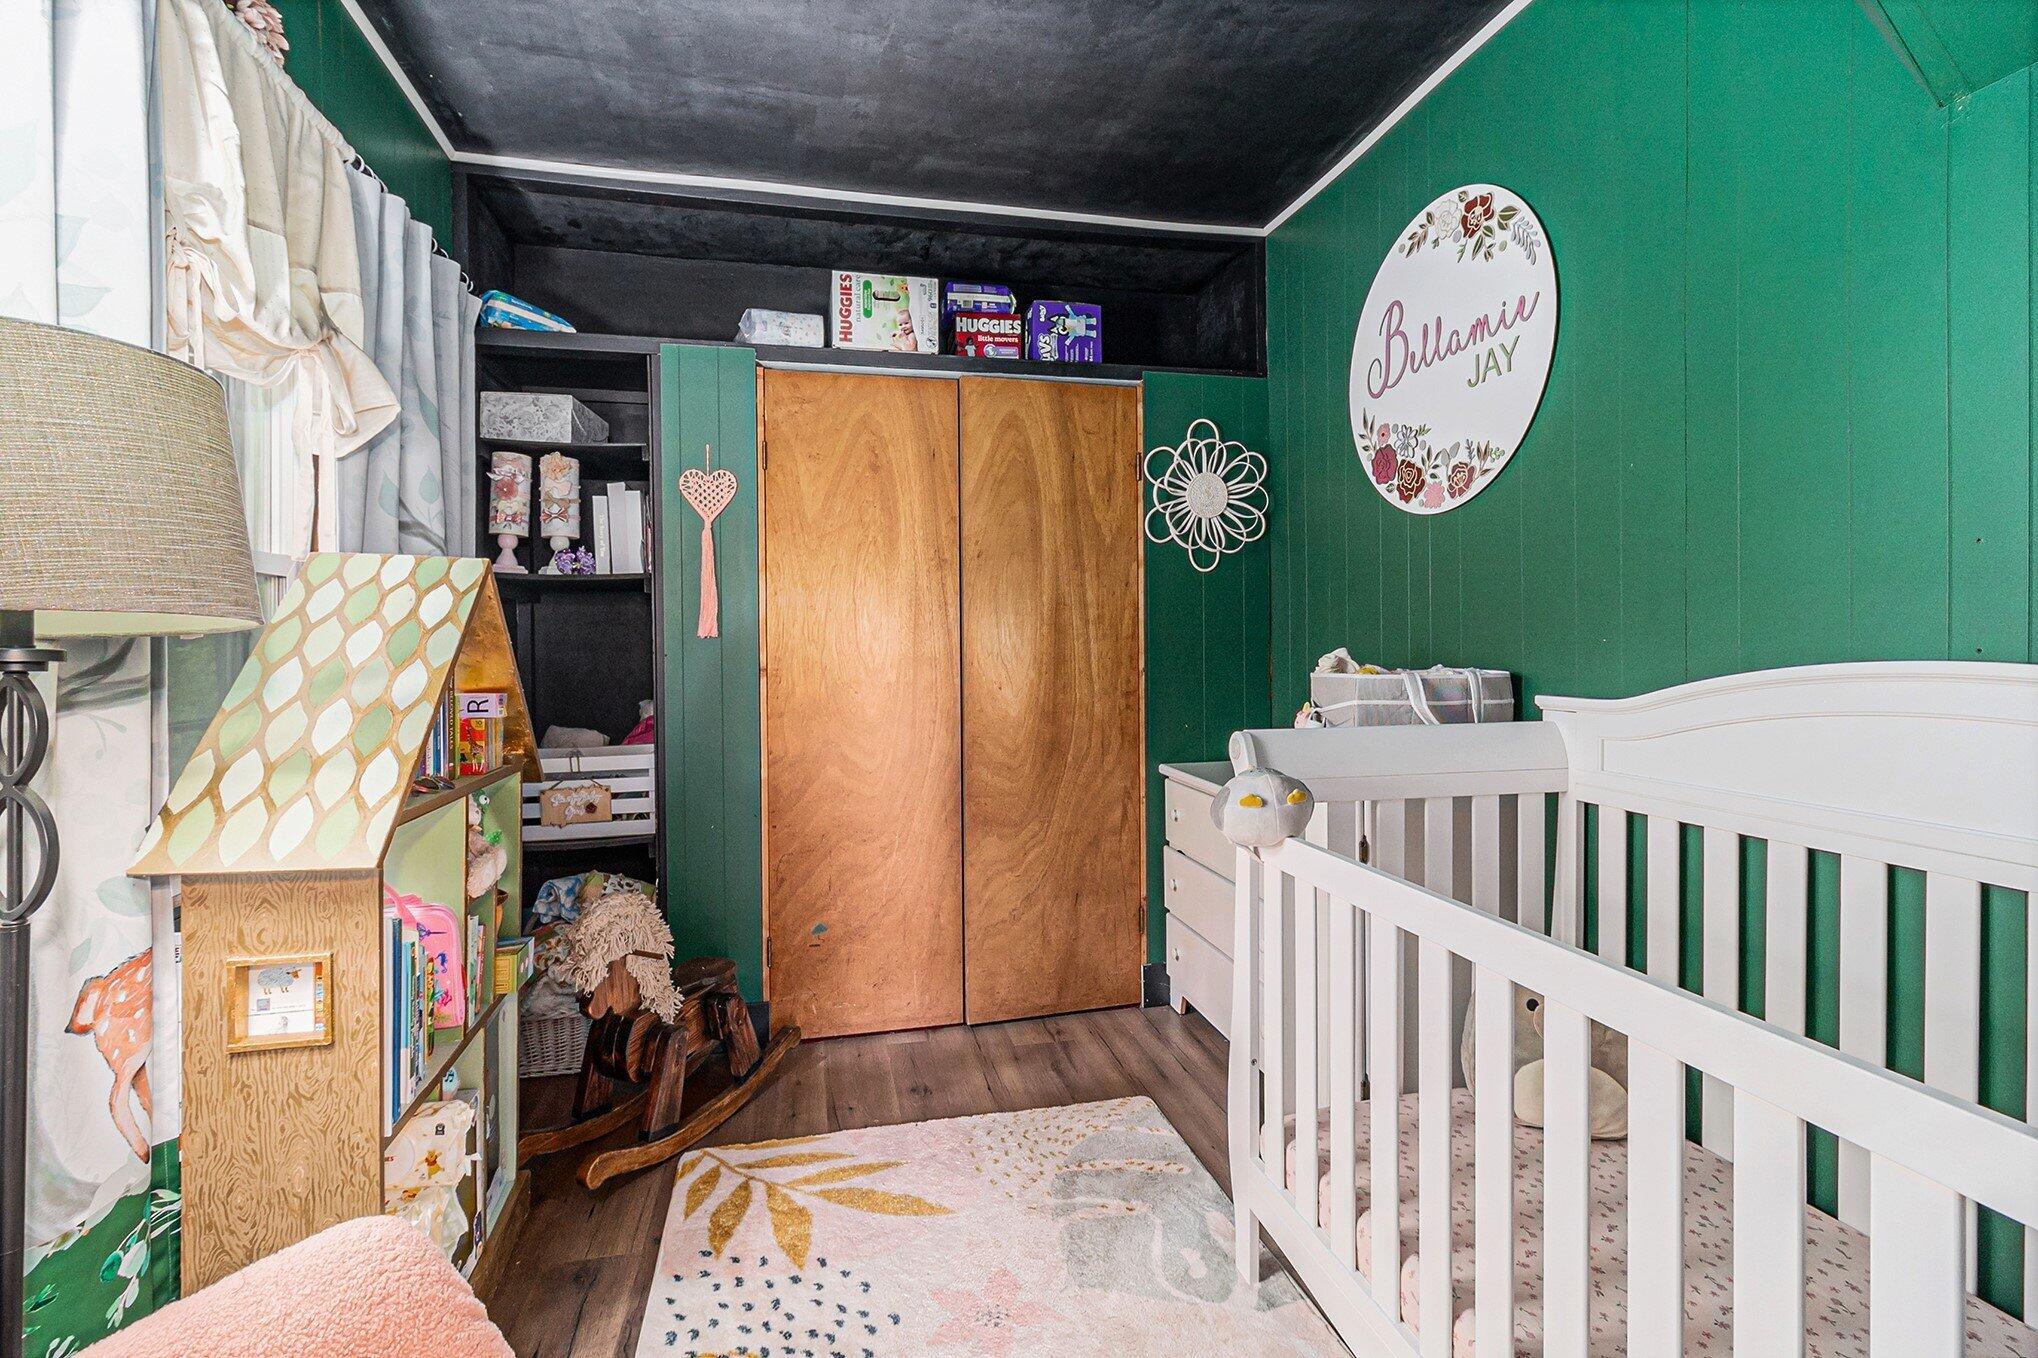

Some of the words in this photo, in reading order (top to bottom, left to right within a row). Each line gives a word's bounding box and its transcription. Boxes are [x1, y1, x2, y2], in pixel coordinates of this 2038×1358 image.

[854, 274, 862, 292] care
[839, 273, 853, 343] HUGGIES
[854, 293, 862, 323] natural
[956, 316, 1021, 334] HUGGIES
[977, 334, 993, 343] little
[1367, 291, 1540, 400] Bellamie
[1467, 335, 1521, 389] JAY
